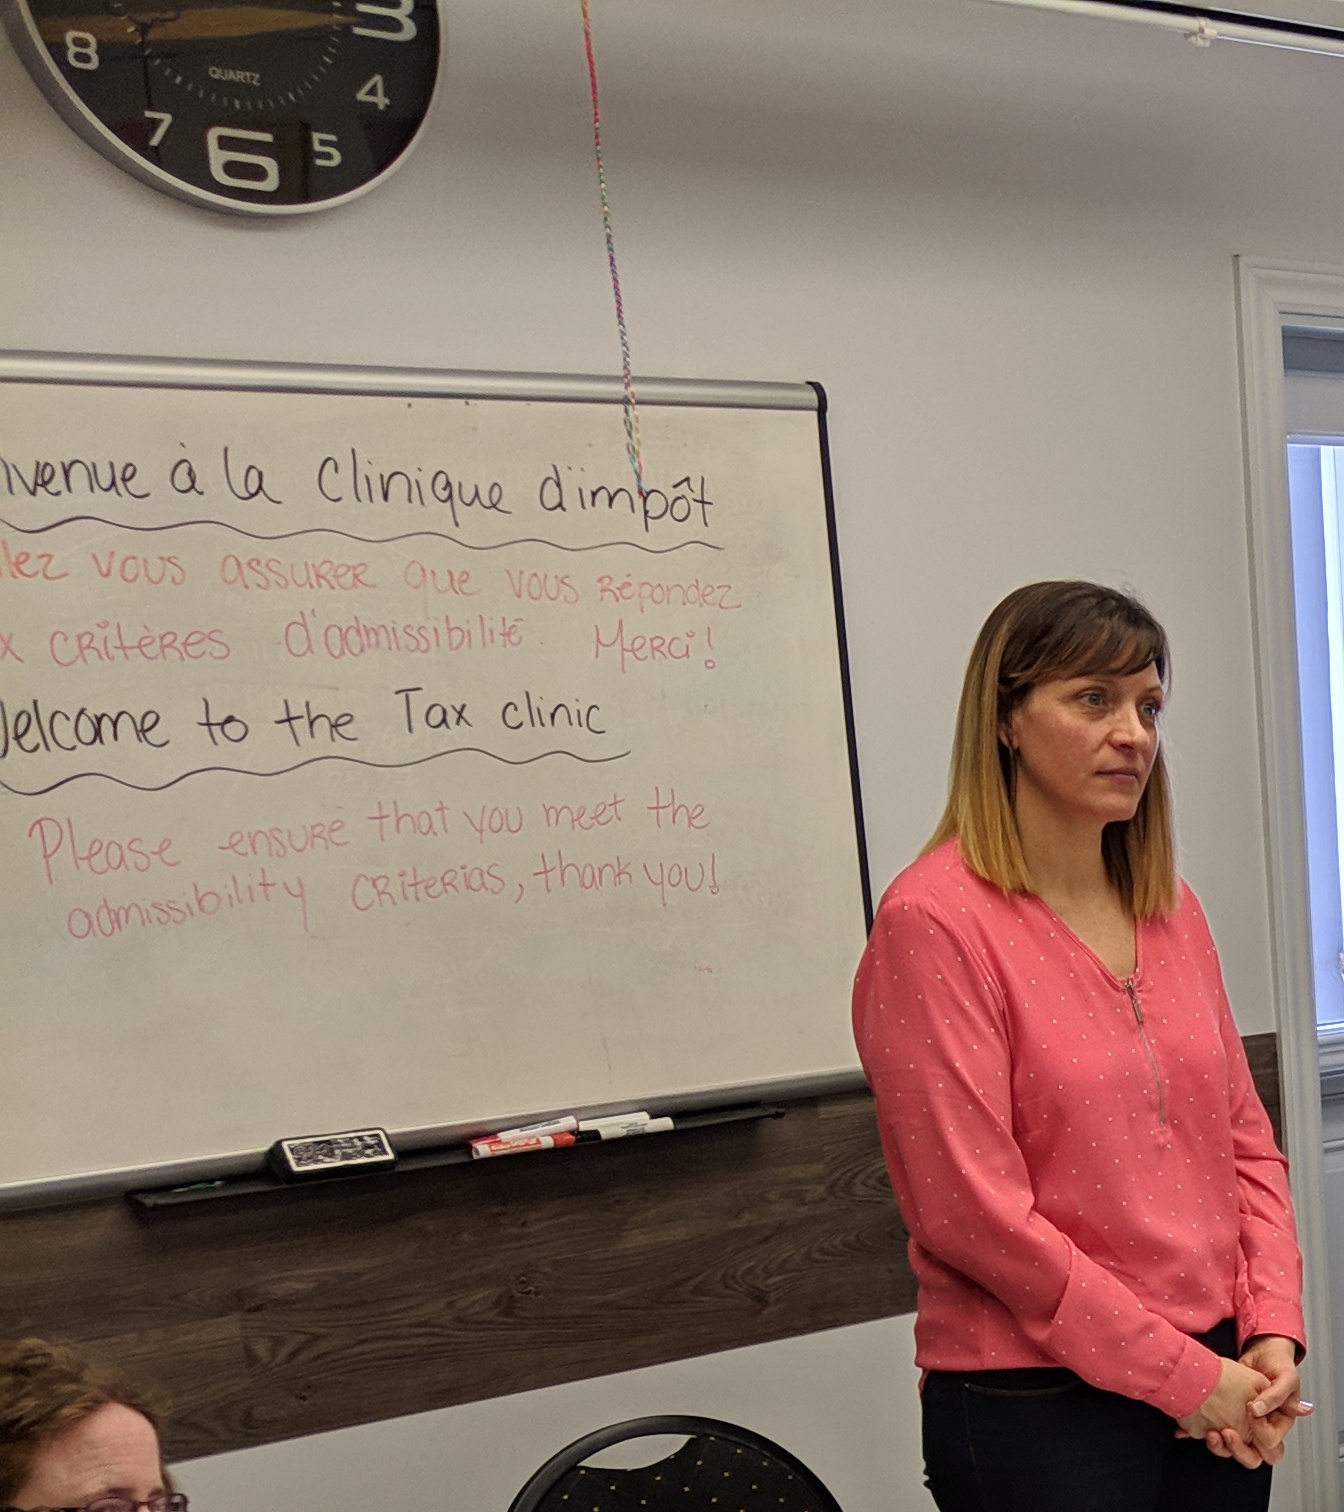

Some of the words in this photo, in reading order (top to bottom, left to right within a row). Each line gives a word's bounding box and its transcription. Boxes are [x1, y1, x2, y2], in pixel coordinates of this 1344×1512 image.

[64, 30, 100, 71] 8
[208, 66, 262, 87] QUARTZ
[356, 74, 391, 111] 4
[143, 110, 173, 147] 7
[311, 132, 343, 168] 5
[206, 126, 280, 193] 6
[169, 441, 205, 497] à
[223, 446, 283, 505] la
[403, 559, 482, 618] que
[197, 697, 250, 747] to
[274, 699, 359, 747] the
[393, 686, 474, 735] Tax
[500, 690, 607, 735] clinic
[28, 815, 183, 885] Please
[367, 800, 450, 843] that
[462, 803, 524, 845] you
[542, 792, 627, 832] meet
[646, 785, 712, 831] the
[67, 867, 311, 940] admissibility
[532, 850, 633, 894] thank
